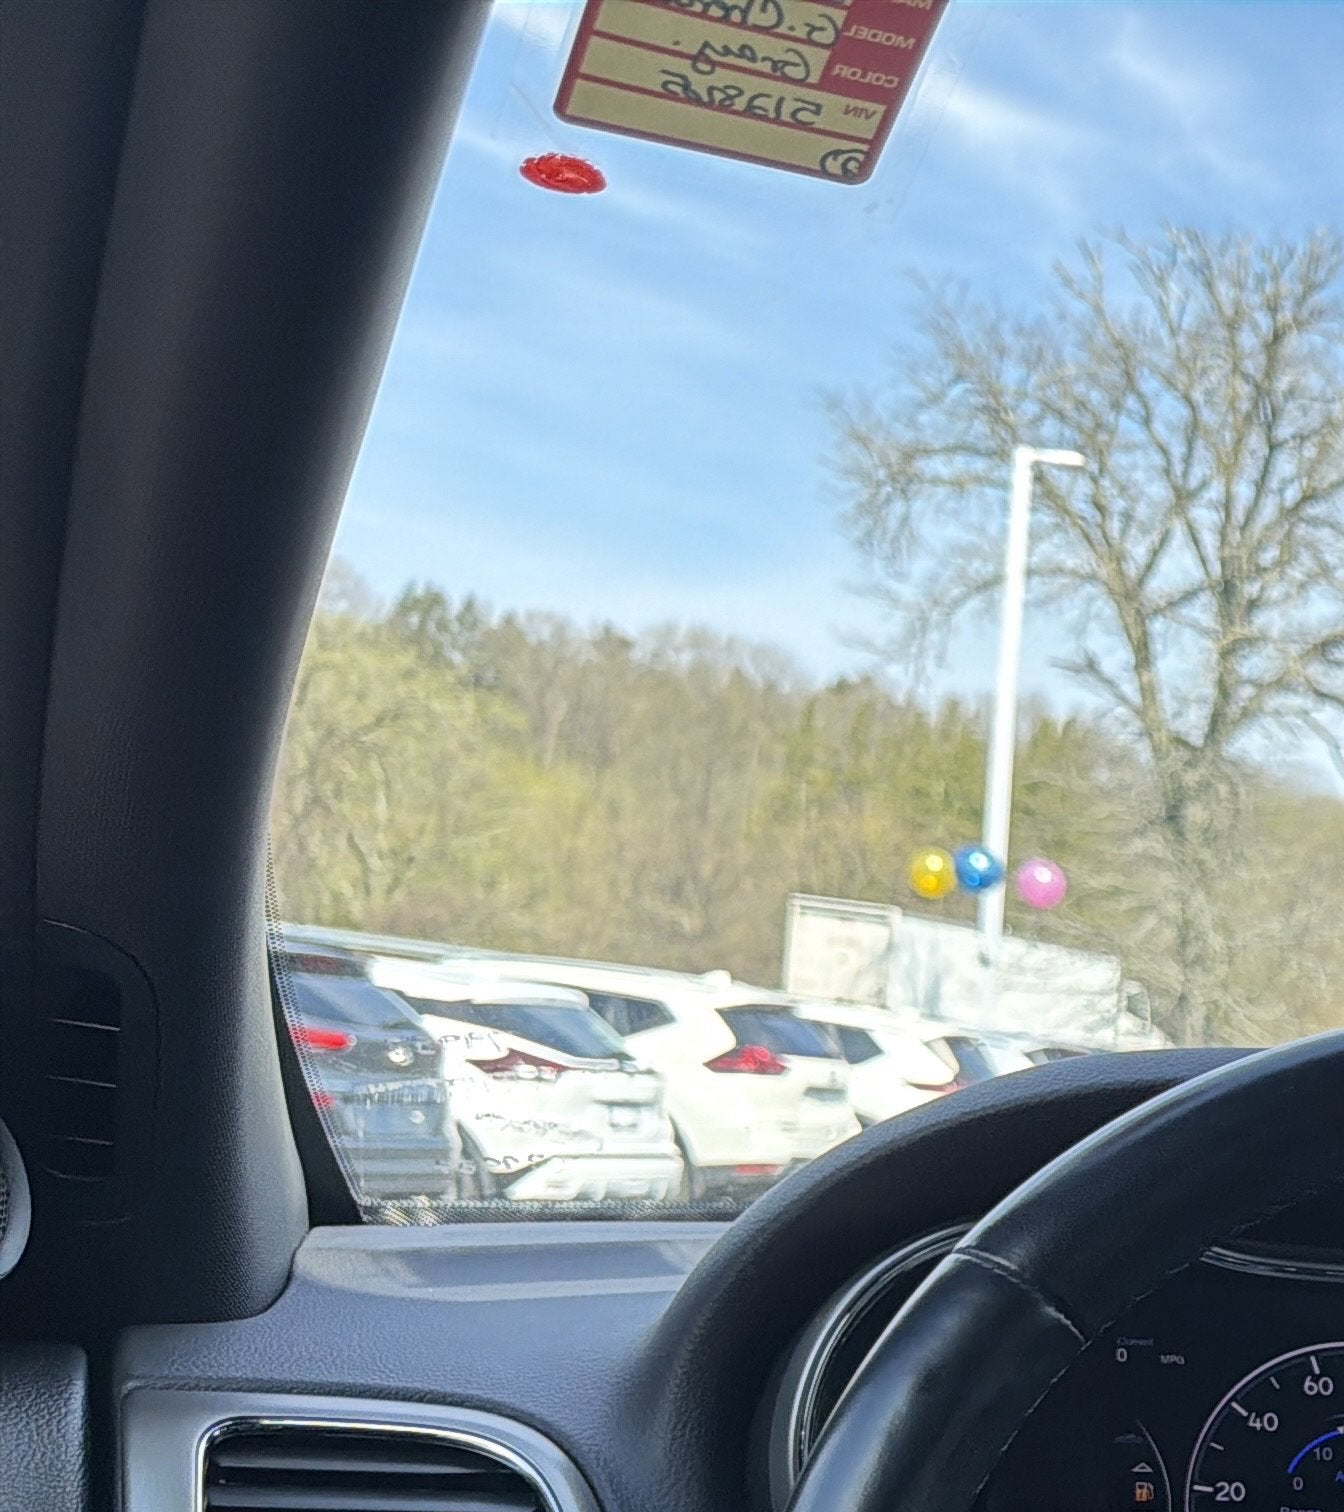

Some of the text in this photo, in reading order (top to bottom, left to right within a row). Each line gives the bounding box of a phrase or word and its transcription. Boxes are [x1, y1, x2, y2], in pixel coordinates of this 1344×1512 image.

[1115, 1348, 1128, 1363] 0
[1303, 1376, 1334, 1397] 60
[1247, 1412, 1279, 1432] 40
[1313, 1447, 1332, 1461] 10
[1215, 1482, 1246, 1502] 20
